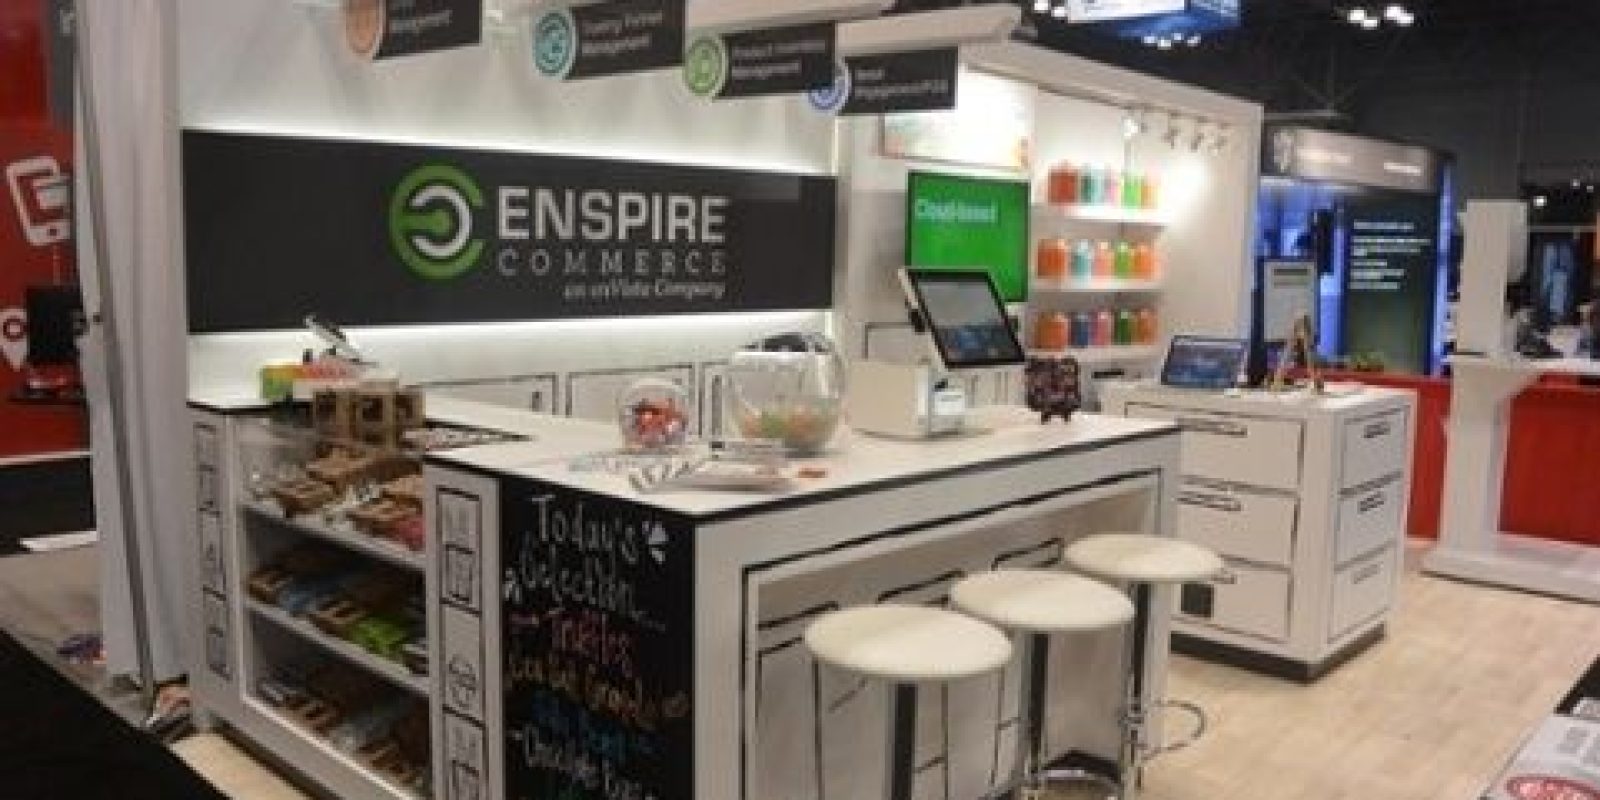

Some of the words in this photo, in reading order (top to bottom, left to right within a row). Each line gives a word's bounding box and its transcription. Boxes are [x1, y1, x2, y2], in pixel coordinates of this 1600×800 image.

[498, 186, 728, 243] ENSPIRE
[499, 250, 727, 276] COMMERCE
[654, 278, 727, 300] Company
[532, 495, 640, 565] Today's
